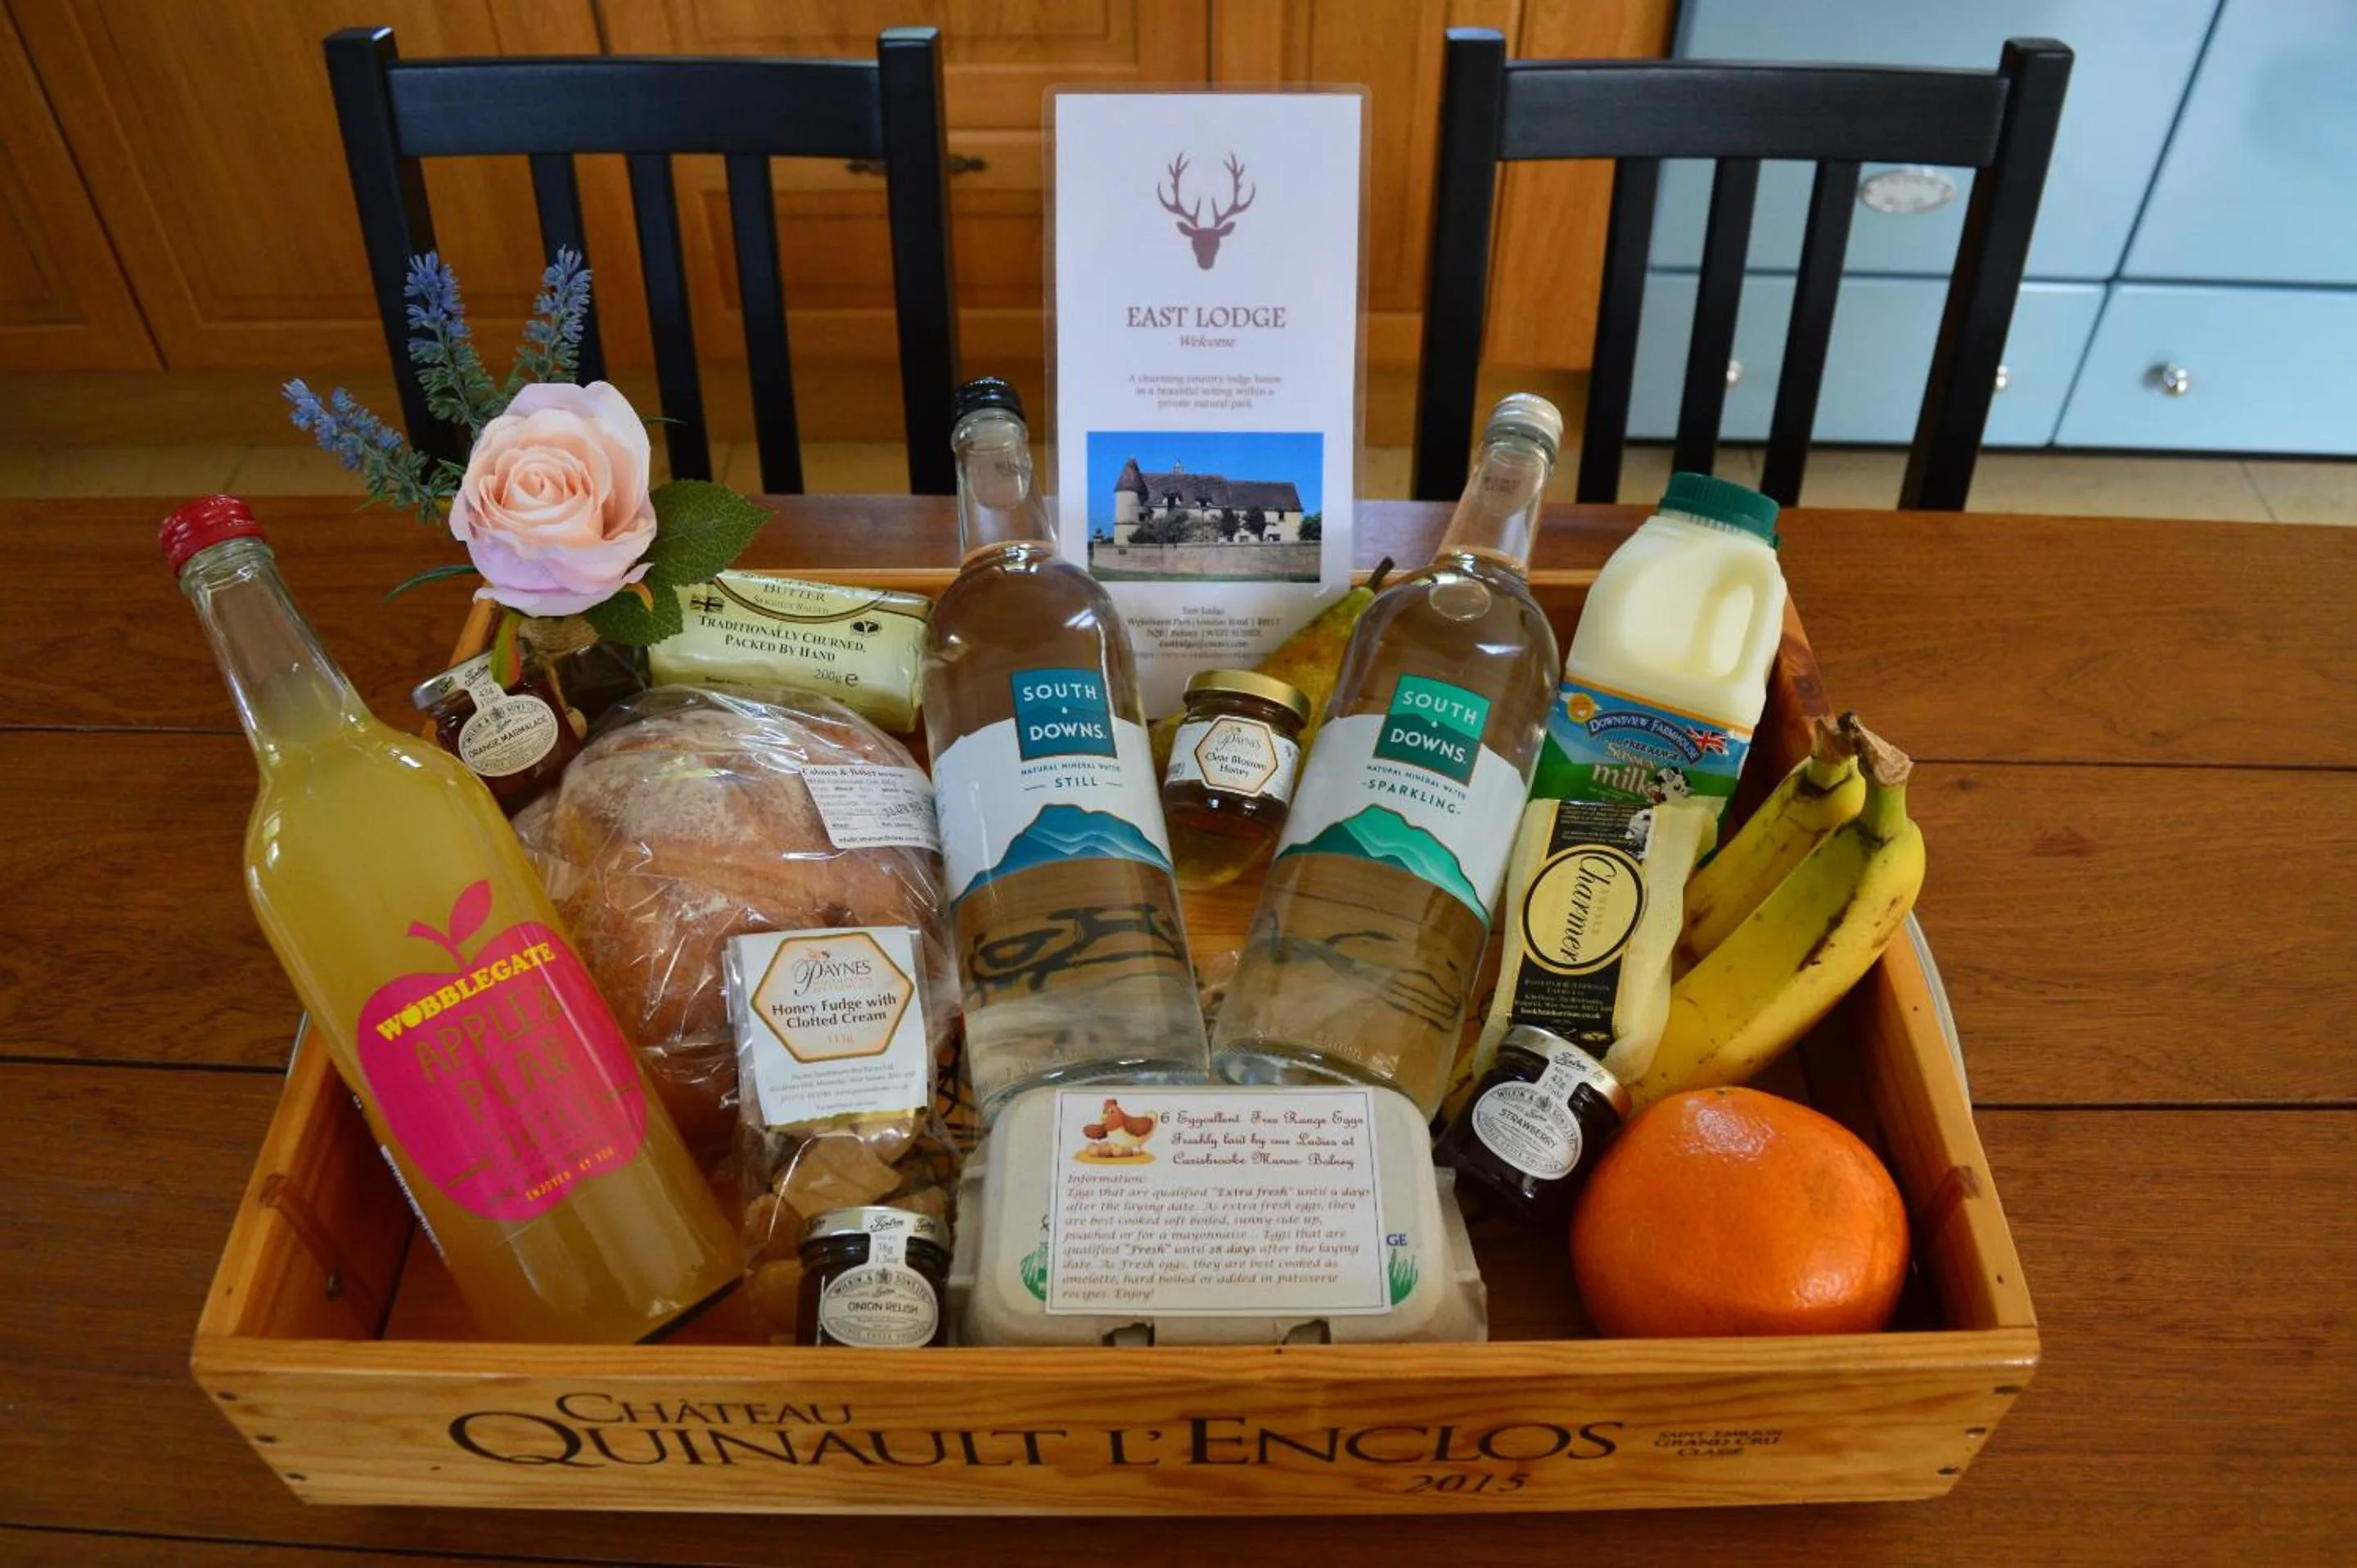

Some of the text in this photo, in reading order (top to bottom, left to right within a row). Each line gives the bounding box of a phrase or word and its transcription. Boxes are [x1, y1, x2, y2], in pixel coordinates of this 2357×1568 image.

[1126, 306, 1287, 328] EAST LODGE
[1179, 335, 1237, 349] Welcome
[698, 615, 799, 643] TRADITIONALLY
[724, 635, 836, 662] PACKED BY HAND
[1023, 683, 1097, 702] SOUTH
[1402, 690, 1478, 726] SOUTH
[1029, 722, 1105, 741] DOWNS
[1390, 728, 1467, 764] DOWNS
[1021, 764, 1058, 776] NATURAL
[1061, 763, 1096, 771] MINERAL
[1219, 764, 1249, 777] Honey
[1366, 764, 1402, 777] NATURAL
[1404, 772, 1440, 788] MINERAL
[1054, 777, 1099, 789] STILL
[1593, 764, 1653, 798] milk
[1367, 778, 1457, 815] SPARKLING
[1559, 855, 1618, 963] Charmer
[791, 957, 872, 998] PAYNES
[376, 941, 557, 1043] WOBBLEGATE
[772, 992, 897, 1016] Honey Fudge with
[786, 1011, 887, 1030] Clotted Cream
[1160, 1111, 1170, 1124] 6
[1250, 1111, 1278, 1124] Free
[1282, 1111, 1327, 1129] Range
[1331, 1110, 1364, 1129] Eggs
[1497, 1107, 1557, 1149] STRAWBERRY
[1170, 1132, 1218, 1150] Freshly
[1223, 1132, 1246, 1146] laid
[1250, 1132, 1266, 1149] by
[1296, 1132, 1339, 1147] Ladies
[1341, 1134, 1356, 1147] at
[1172, 1151, 1355, 1170] Carisbrooke Manor Bolney
[1067, 1187, 1095, 1200] Eggs
[1098, 1187, 1125, 1197] that
[1152, 1187, 1208, 1201] qualified
[1296, 1187, 1327, 1197] until
[1341, 1187, 1371, 1199] days
[1066, 1201, 1095, 1212] after
[1101, 1201, 1120, 1211] the
[1124, 1201, 1165, 1214] laying
[1222, 1201, 1257, 1211] extra
[1260, 1201, 1291, 1212] fresh
[1327, 1201, 1356, 1212] they
[1066, 1218, 1087, 1226] are
[1090, 1215, 1114, 1226] best
[1117, 1215, 1160, 1226] cooked
[1164, 1215, 1185, 1228] soft
[1065, 1231, 1116, 1243] poached
[1120, 1232, 1133, 1241] or
[1137, 1230, 1155, 1241] for
[1263, 1229, 1292, 1241] Eggs
[1295, 1228, 1322, 1240] that
[1324, 1231, 1346, 1239] are
[1065, 1245, 1120, 1257] qualified
[1174, 1245, 1206, 1255] until
[1226, 1244, 1256, 1255] days
[1259, 1244, 1291, 1255] after
[1294, 1243, 1315, 1254] the
[1318, 1243, 1359, 1257] laying
[1193, 1259, 1221, 1272] they
[1224, 1260, 1246, 1269] are
[1250, 1259, 1274, 1269] best
[1278, 1259, 1321, 1269] cooked
[1323, 1260, 1339, 1269] as
[1062, 1273, 1120, 1286] omelette,
[1123, 1273, 1155, 1284] hard
[1158, 1273, 1197, 1284] boiled
[1200, 1276, 1213, 1284] or
[1216, 1273, 1257, 1284] added
[1260, 1274, 1273, 1284] in
[1114, 1288, 1156, 1301] Enjoy!
[847, 1301, 919, 1315] ONION RELISH
[447, 1410, 1069, 1469] QUINAULT
[1400, 1473, 1533, 1495] 2015
